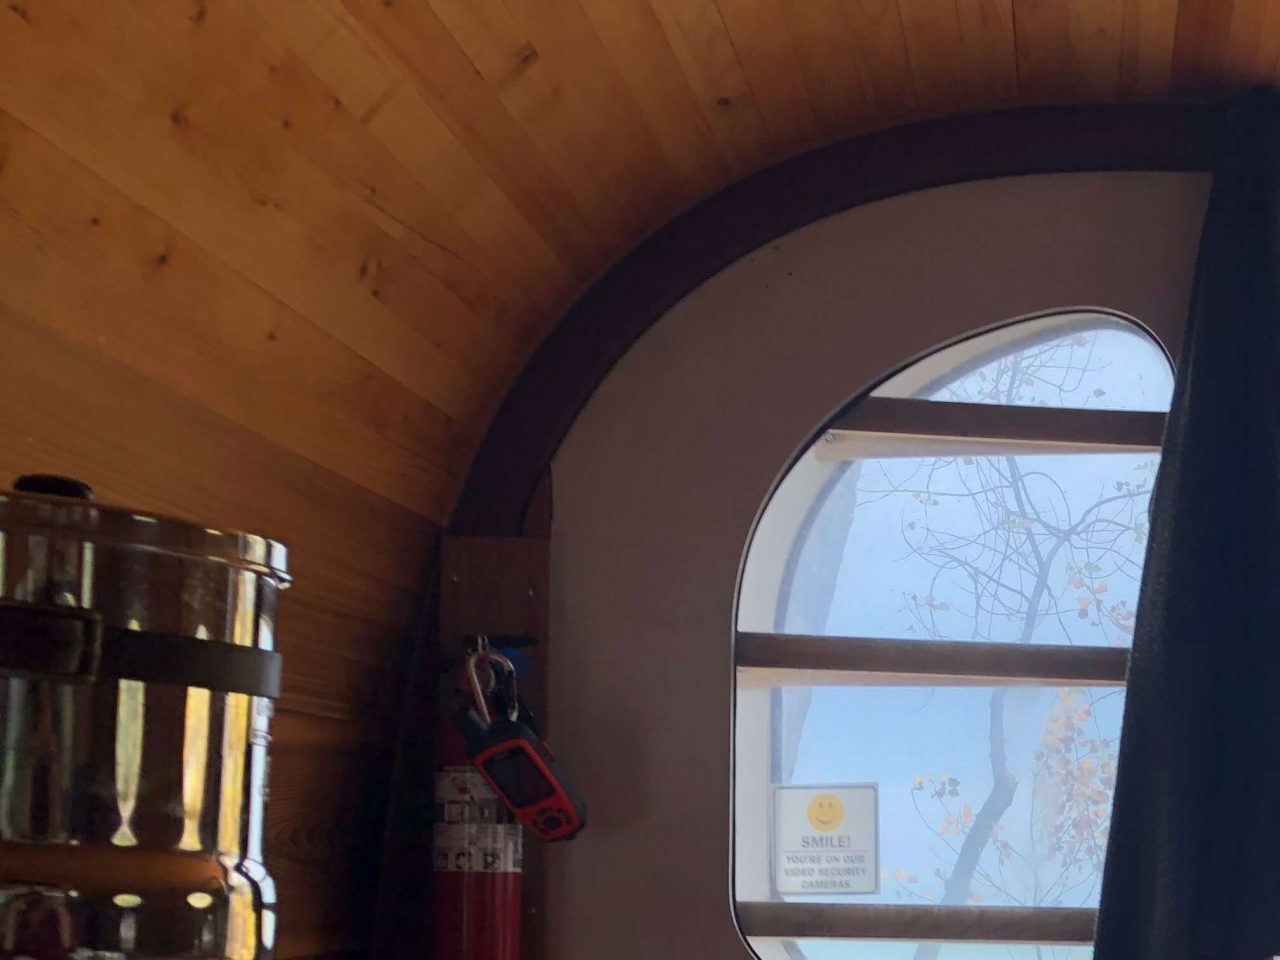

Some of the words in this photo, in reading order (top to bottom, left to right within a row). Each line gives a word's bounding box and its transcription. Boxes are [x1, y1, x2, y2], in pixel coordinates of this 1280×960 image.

[801, 835, 851, 849] SMILE!
[825, 854, 839, 865] ON
[843, 854, 865, 864] OUR
[784, 867, 815, 878] VIDEO
[817, 866, 867, 878] SECURITY
[800, 879, 851, 890] CAMERAS
